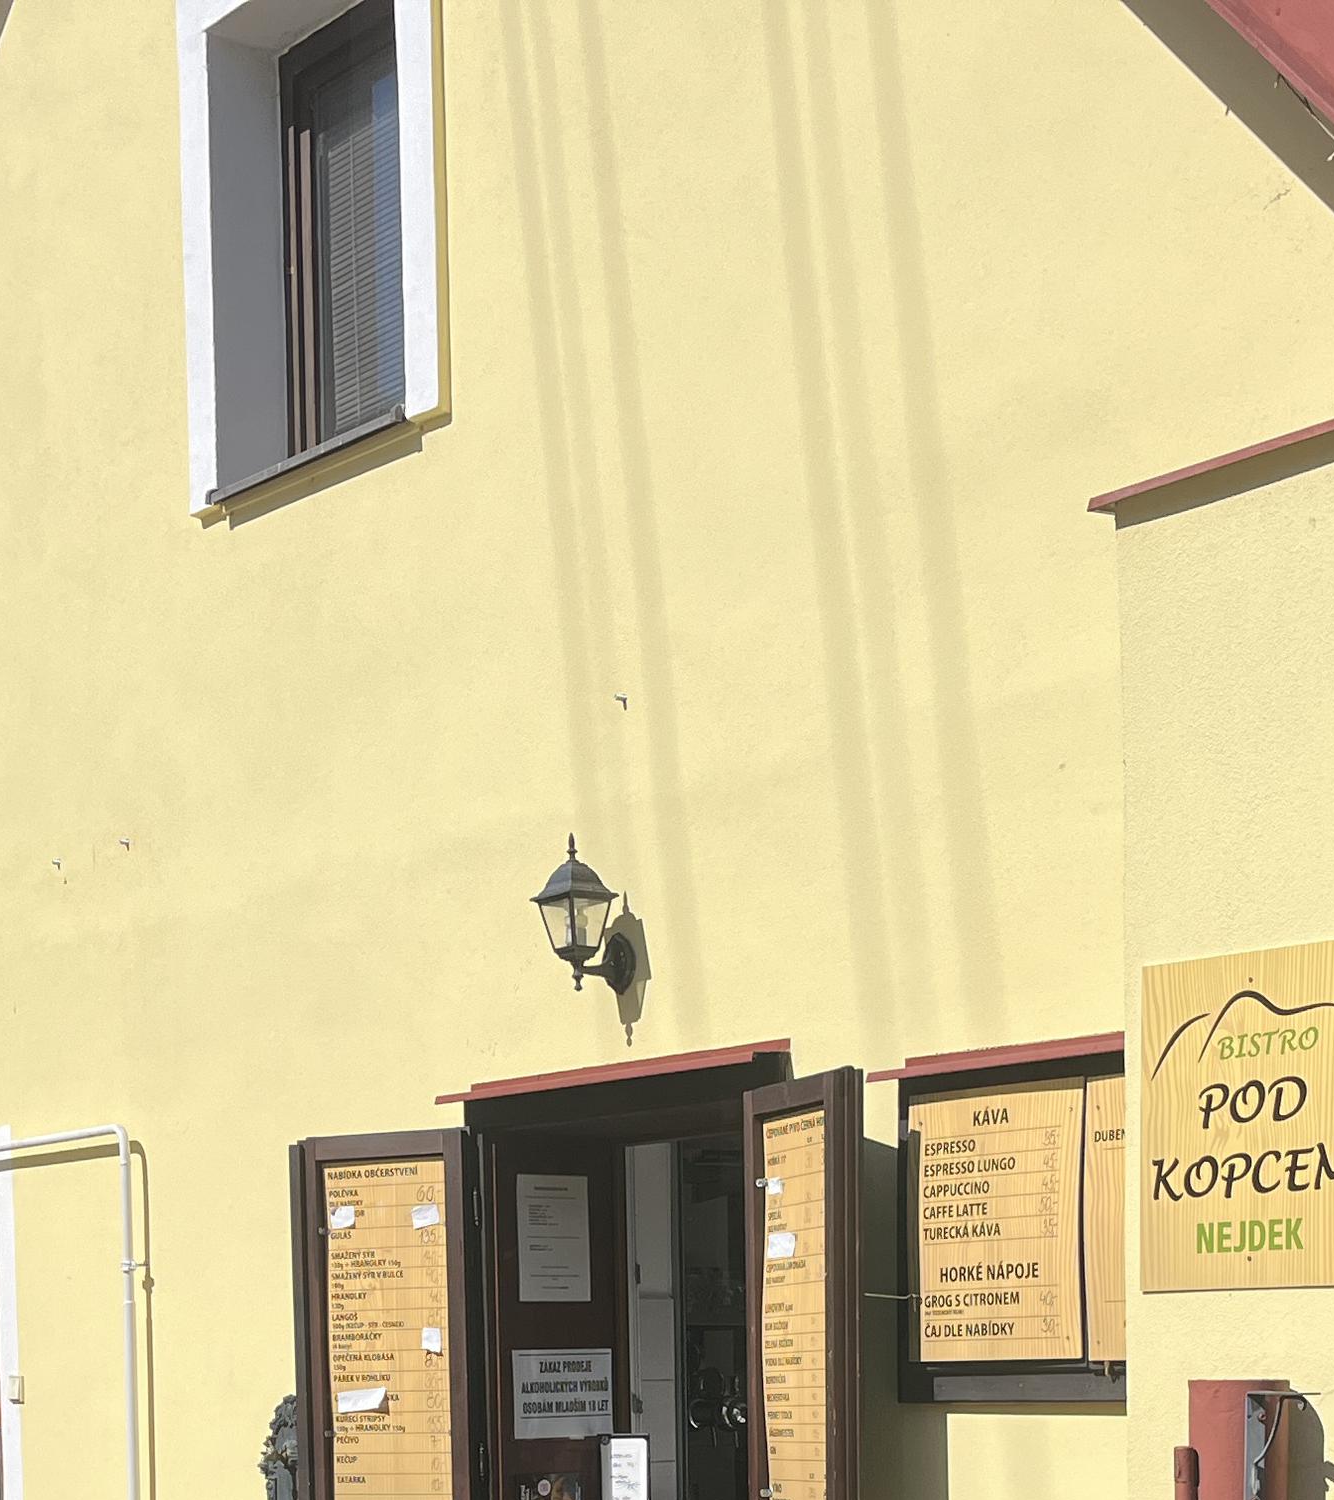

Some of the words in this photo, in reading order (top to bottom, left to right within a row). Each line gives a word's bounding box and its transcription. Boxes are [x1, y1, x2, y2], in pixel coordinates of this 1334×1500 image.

[1217, 1025, 1319, 1061] BISTRO
[1198, 1075, 1308, 1130] POD
[972, 1106, 1009, 1127] KÁVA
[924, 1139, 976, 1157] ESPRESSO
[327, 1168, 362, 1180] NABÍDKA
[364, 1164, 418, 1179] OBČERSTVENÍ
[924, 1160, 975, 1178] ESPRESSO
[977, 1156, 1016, 1173] LUNGO
[923, 1180, 990, 1199] CAPPUCCINO
[923, 1205, 954, 1220] CAFFE
[956, 1202, 988, 1217] LATTE
[923, 1223, 971, 1241] TURECKÁ
[971, 1221, 1001, 1238] KÁVA
[1196, 1218, 1304, 1254] NEJDEK
[939, 1262, 983, 1283] HORKÉ
[986, 1260, 1040, 1281] NÁPOJE
[924, 1294, 953, 1308] GROG
[954, 1294, 961, 1307] S
[963, 1291, 1020, 1306] CITRONEM
[924, 1322, 942, 1338] ČAJ
[944, 1324, 963, 1338] DLE
[965, 1320, 1015, 1337] NABÍDKY
[563, 1359, 592, 1373] PRODEJE
[521, 1379, 578, 1393] ALKOHOLICKÝCH
[597, 1400, 609, 1411] LET
